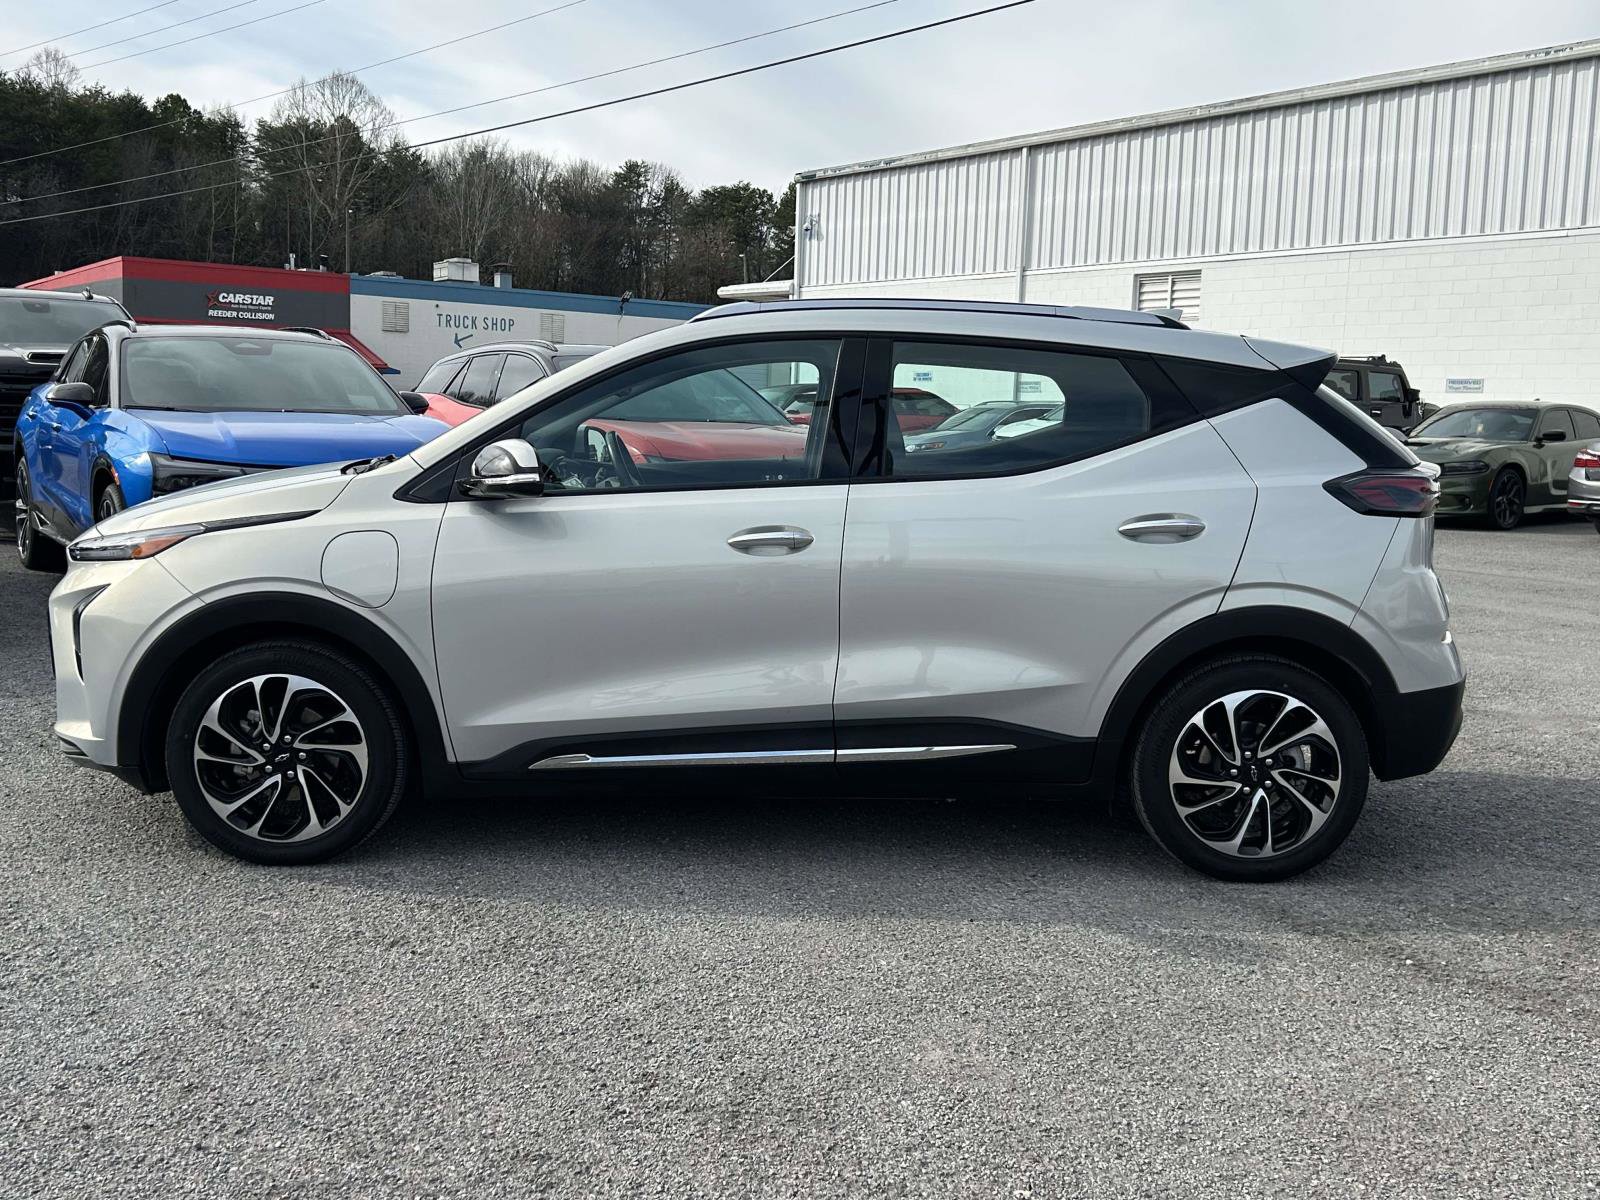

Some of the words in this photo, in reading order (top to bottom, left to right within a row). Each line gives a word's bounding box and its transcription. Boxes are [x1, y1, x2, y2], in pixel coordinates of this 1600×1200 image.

[218, 293, 274, 305] CARSTAR
[208, 309, 237, 318] REEDER
[238, 311, 275, 320] COLLISION
[436, 313, 478, 330] TRUCK
[482, 316, 515, 332] SHOP
